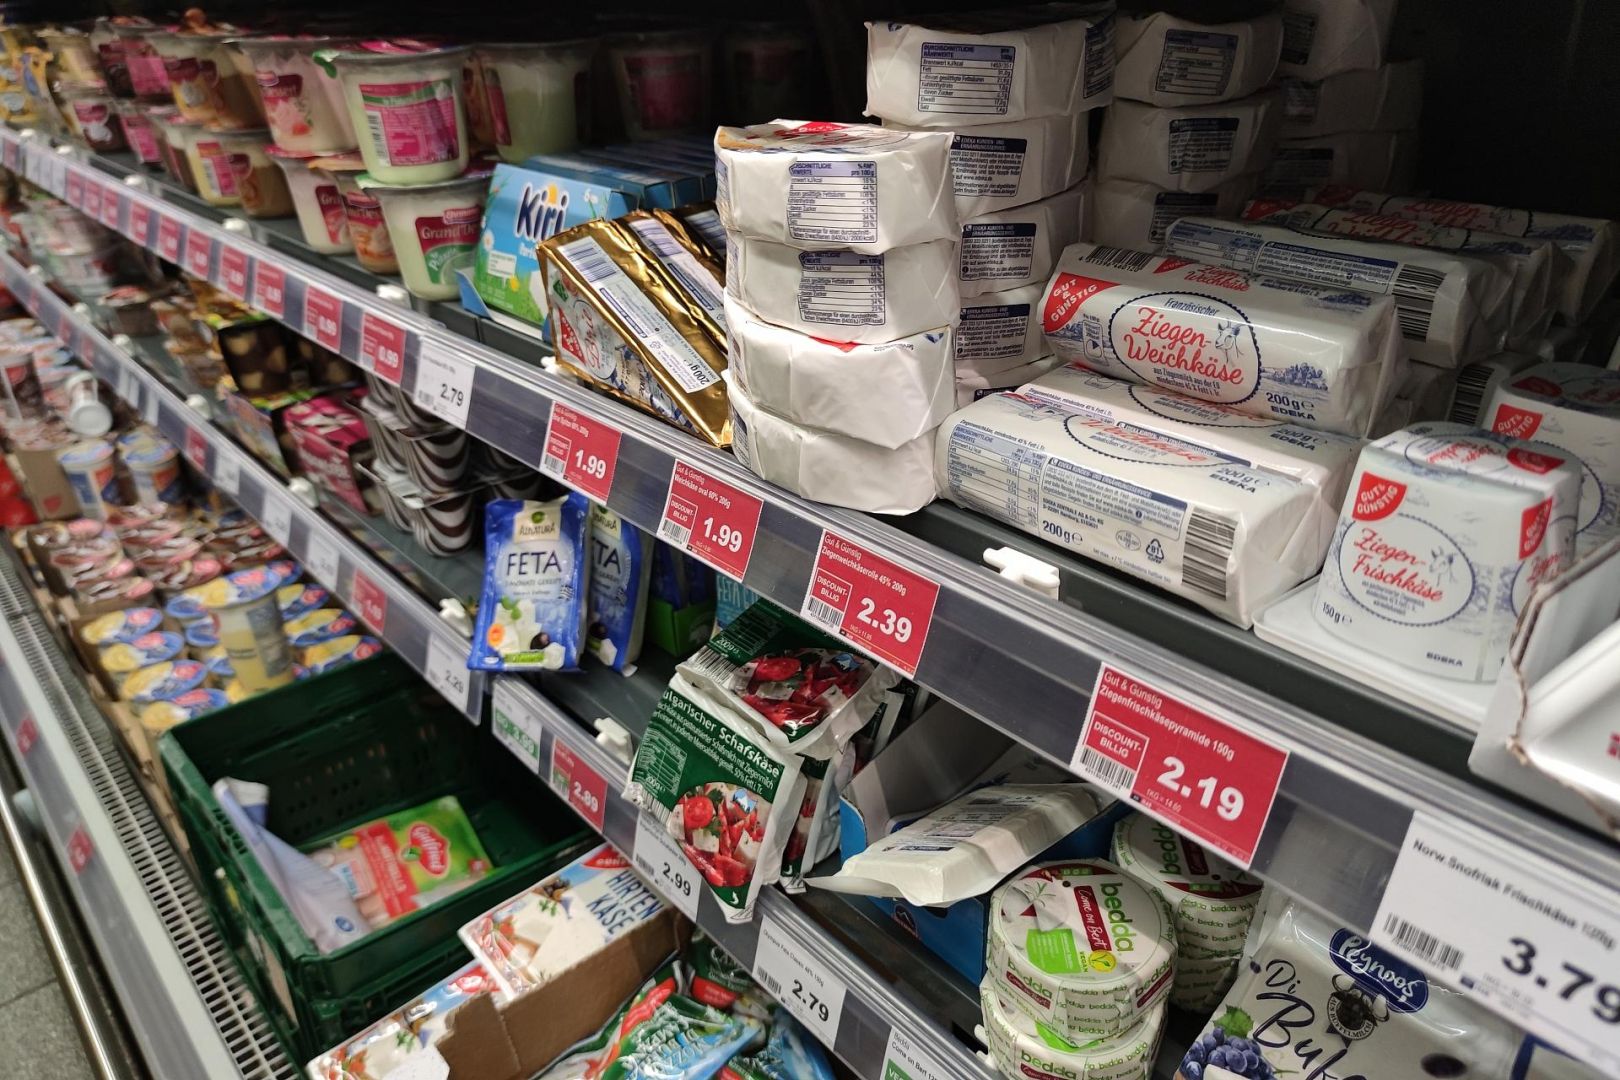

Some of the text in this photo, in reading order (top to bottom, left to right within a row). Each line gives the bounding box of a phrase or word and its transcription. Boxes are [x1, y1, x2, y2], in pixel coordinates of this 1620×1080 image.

[516, 182, 569, 240] Kiri
[1050, 284, 1098, 322] GÜNSTIG
[1053, 279, 1077, 298] GUT
[1062, 291, 1071, 300] &
[1131, 307, 1212, 349] Ziegen-
[1123, 334, 1244, 385] Weichkäse
[440, 383, 465, 407] 2.79
[1270, 405, 1317, 422] EDEKA
[572, 446, 608, 481] 1.99
[1209, 473, 1256, 494] EDEKA
[1356, 484, 1399, 515] GÜNSTIG
[700, 513, 744, 555] 1.99
[823, 533, 863, 561] Gut & Günstig
[1353, 527, 1426, 566] Ziegen-
[506, 550, 563, 577] FETA
[592, 540, 622, 575] TA
[820, 545, 907, 597] Ziegenweichkäserolle 45% 200g
[816, 574, 849, 597] DISCOUNT-
[819, 586, 840, 603] BILLIG
[1352, 553, 1443, 602] Frischkäse
[855, 594, 915, 647] 2.39
[1102, 669, 1164, 710] Gut & Günstig
[660, 688, 719, 732] ulgarischer
[714, 725, 784, 779] Schafskäse
[1092, 719, 1143, 753] DISCOUNT-
[1097, 683, 1236, 763] Ziegenfrischkäsepyramide 150g
[1098, 735, 1130, 759] BILLIG
[1155, 751, 1248, 827] 2.19
[606, 869, 665, 920] HIRTEN
[661, 862, 692, 897] 2.99
[1101, 882, 1135, 954] bedda
[1264, 958, 1302, 994] Di
[1499, 929, 1620, 1031] 3.79
[790, 976, 830, 1025] 2.79
[1020, 1049, 1077, 1080] bedda
